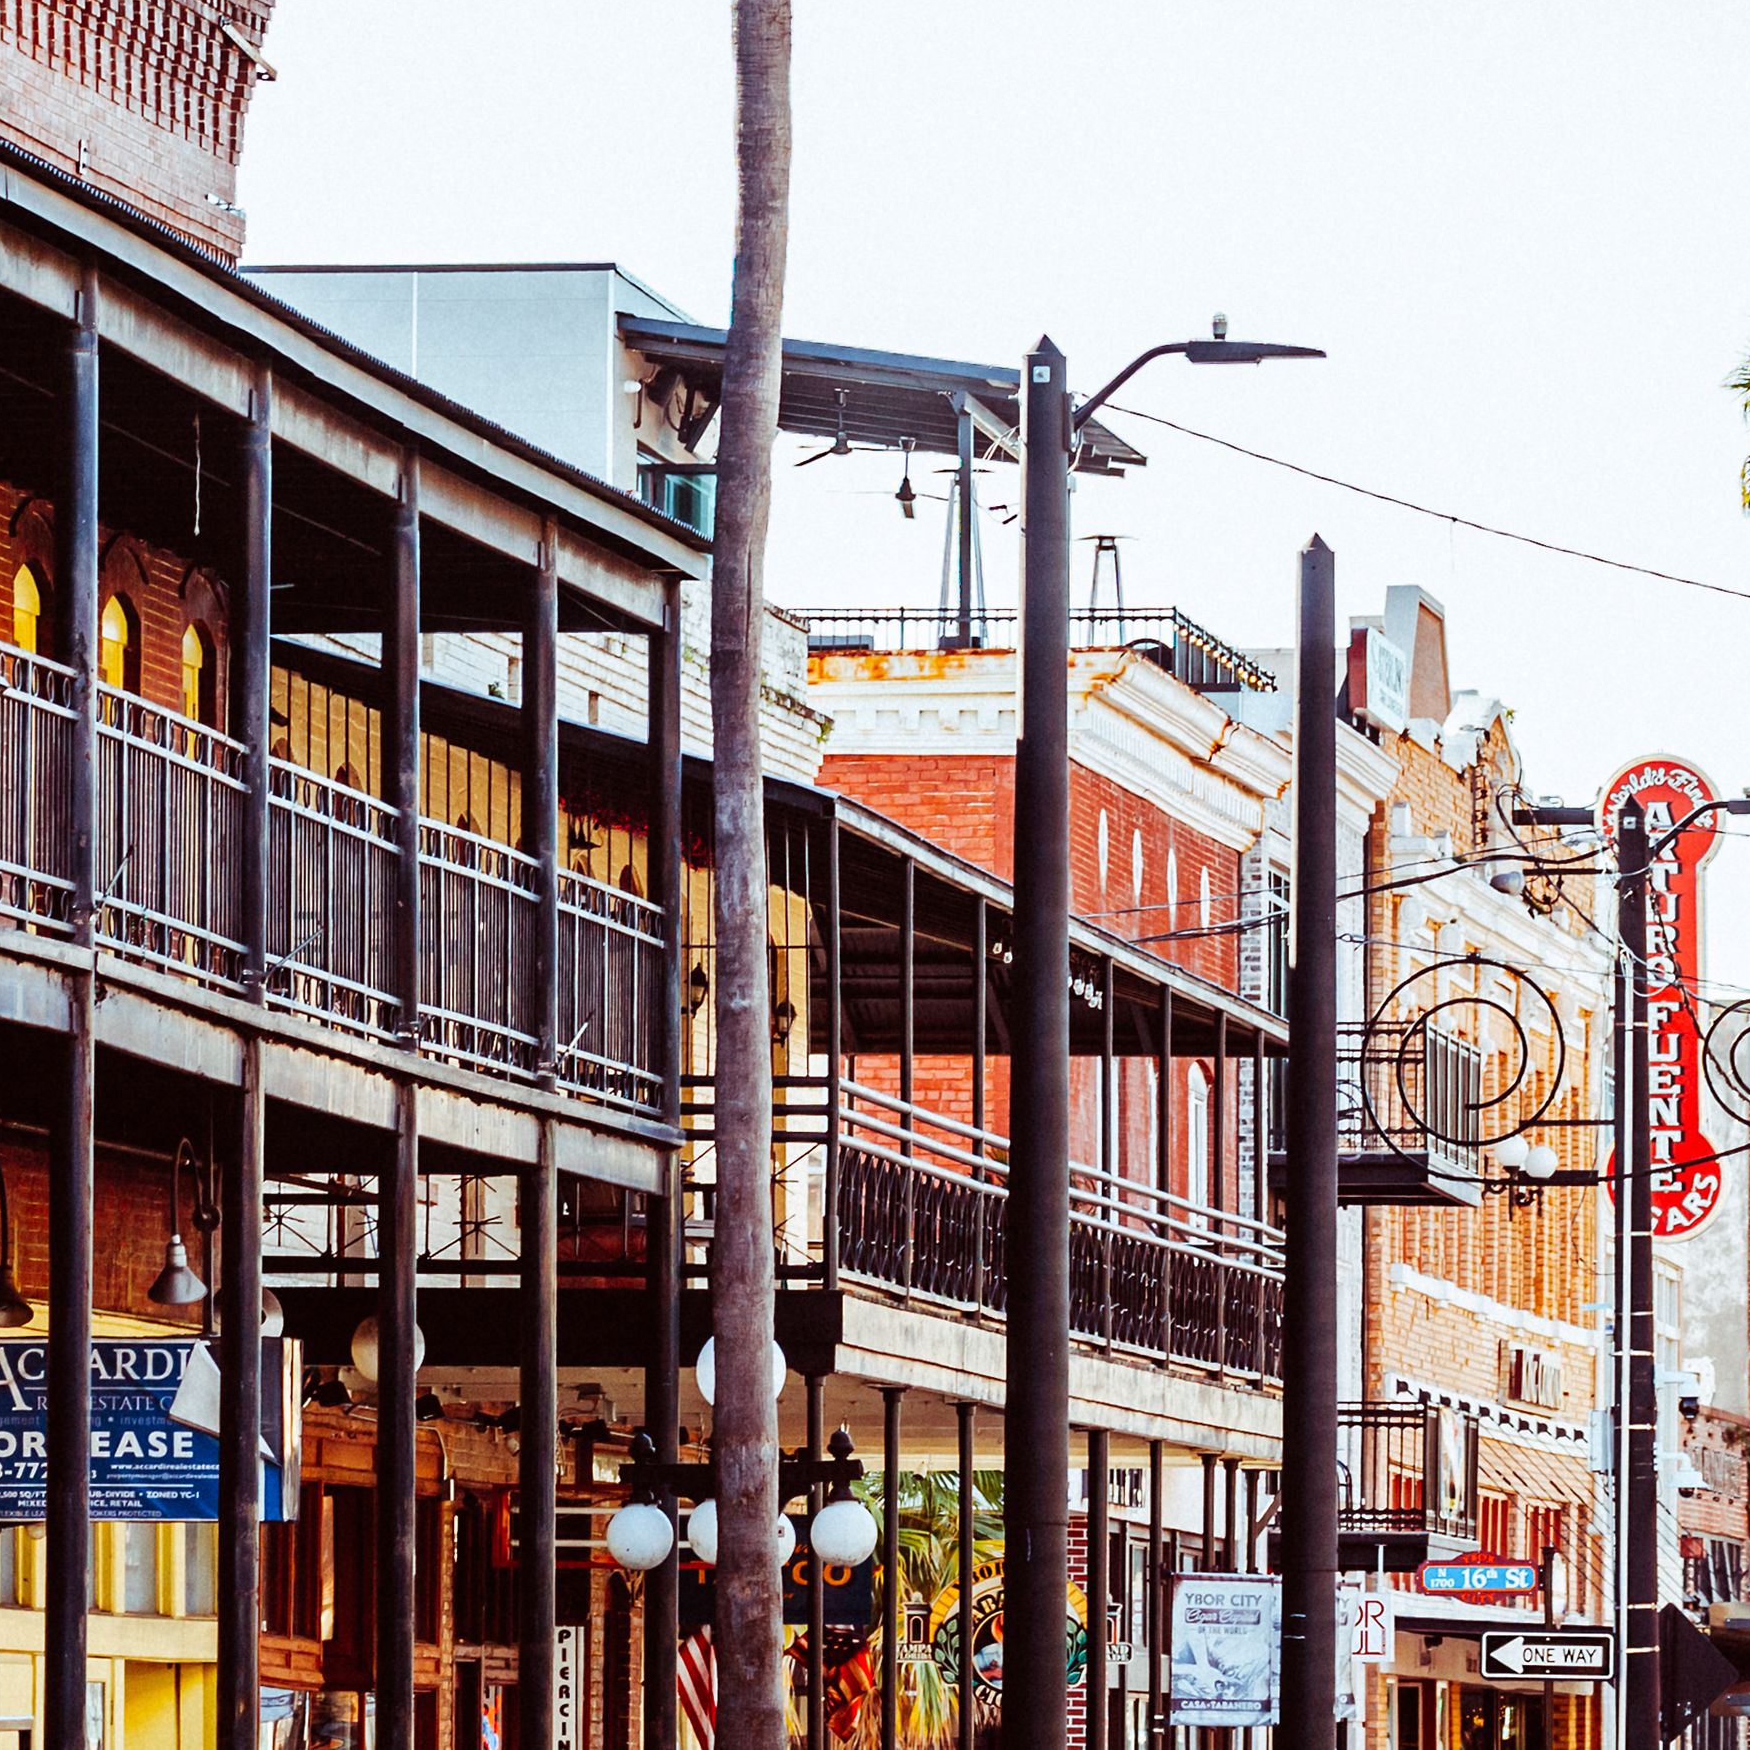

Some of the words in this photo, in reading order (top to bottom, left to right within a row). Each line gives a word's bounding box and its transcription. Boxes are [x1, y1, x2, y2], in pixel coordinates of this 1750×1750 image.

[1647, 1001, 1683, 1193] FUENTE
[90, 1431, 194, 1458] EASE
[88, 1491, 136, 1499] UB-DIVIDE
[1430, 1578, 1456, 1588] 1700
[1461, 1567, 1499, 1589] 16th
[1505, 1568, 1530, 1589] St
[1185, 1593, 1225, 1606] YBOR
[1230, 1594, 1262, 1607] CITY
[1522, 1647, 1555, 1663] ONE
[1562, 1648, 1597, 1664] WAY
